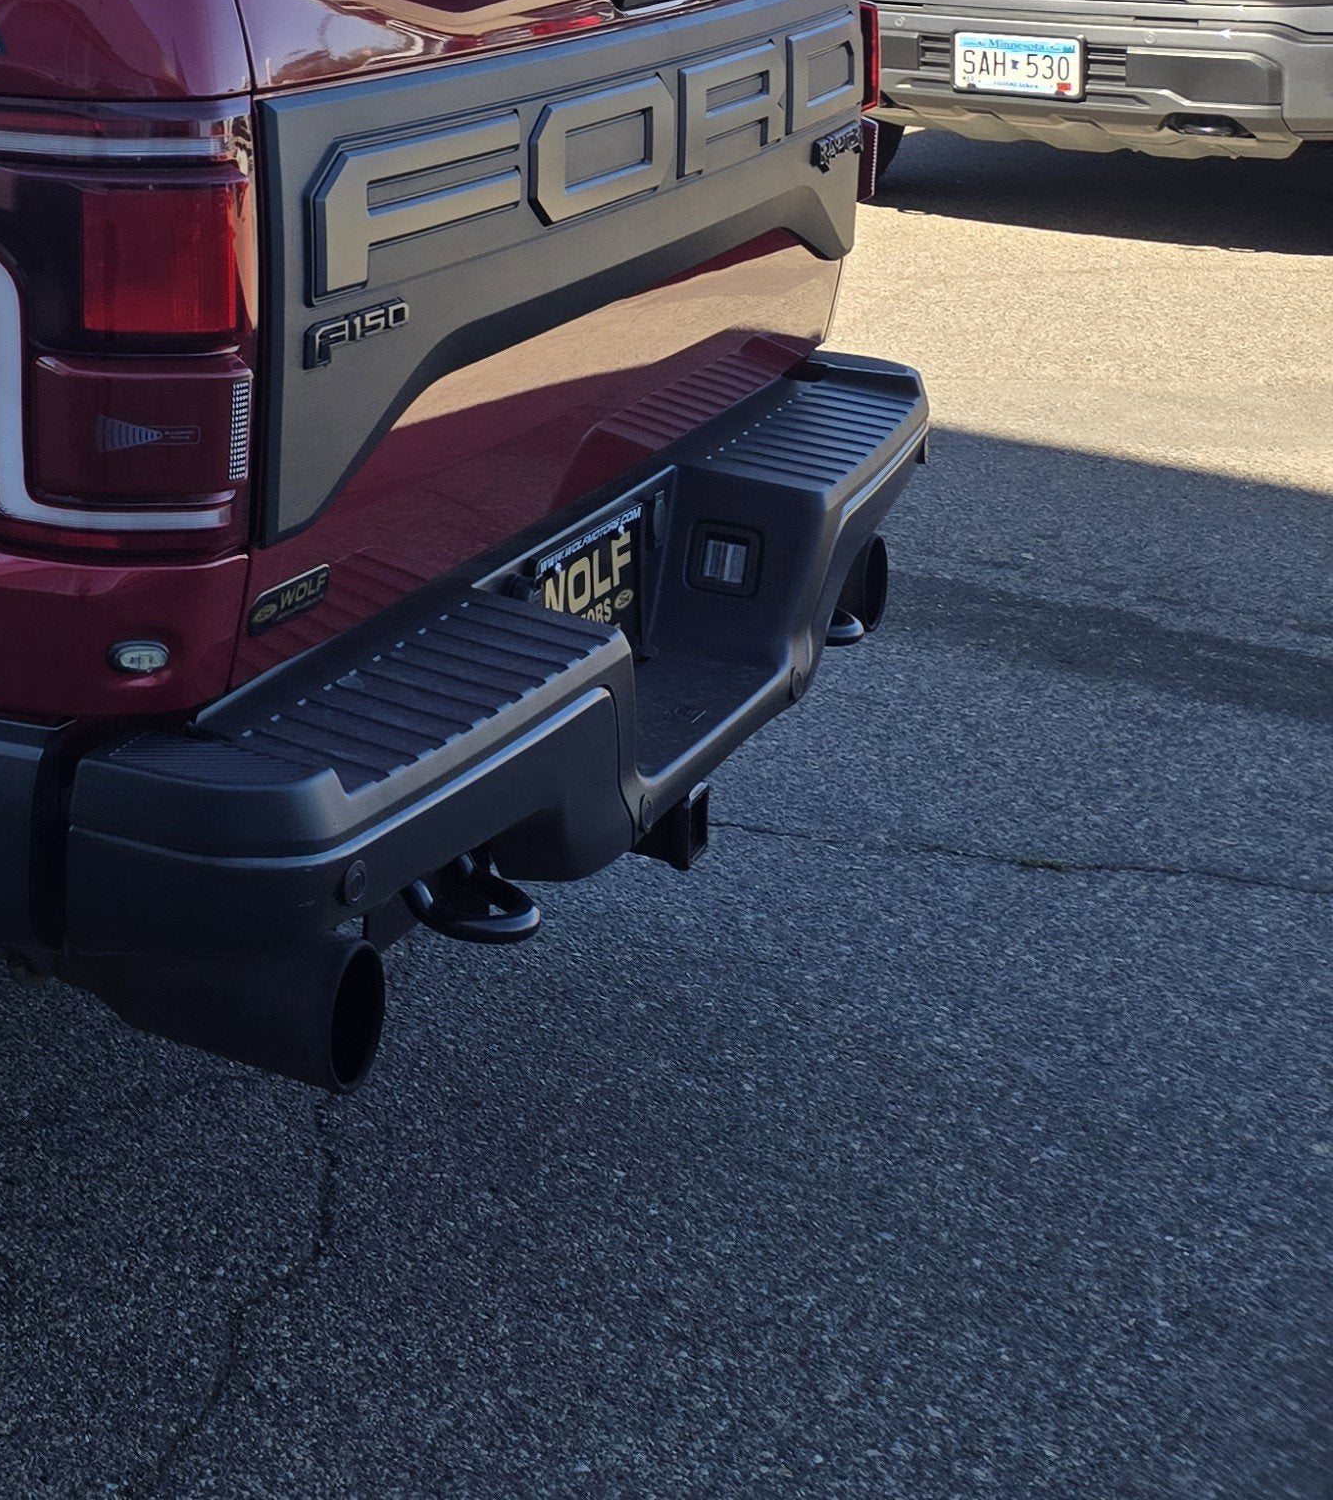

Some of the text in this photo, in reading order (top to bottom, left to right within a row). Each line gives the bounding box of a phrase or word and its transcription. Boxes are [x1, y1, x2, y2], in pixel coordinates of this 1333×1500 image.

[988, 39, 1046, 51] Minnesota
[963, 50, 1070, 80] SAH 530
[308, 12, 862, 298] FORD
[280, 572, 328, 610] WOLF
